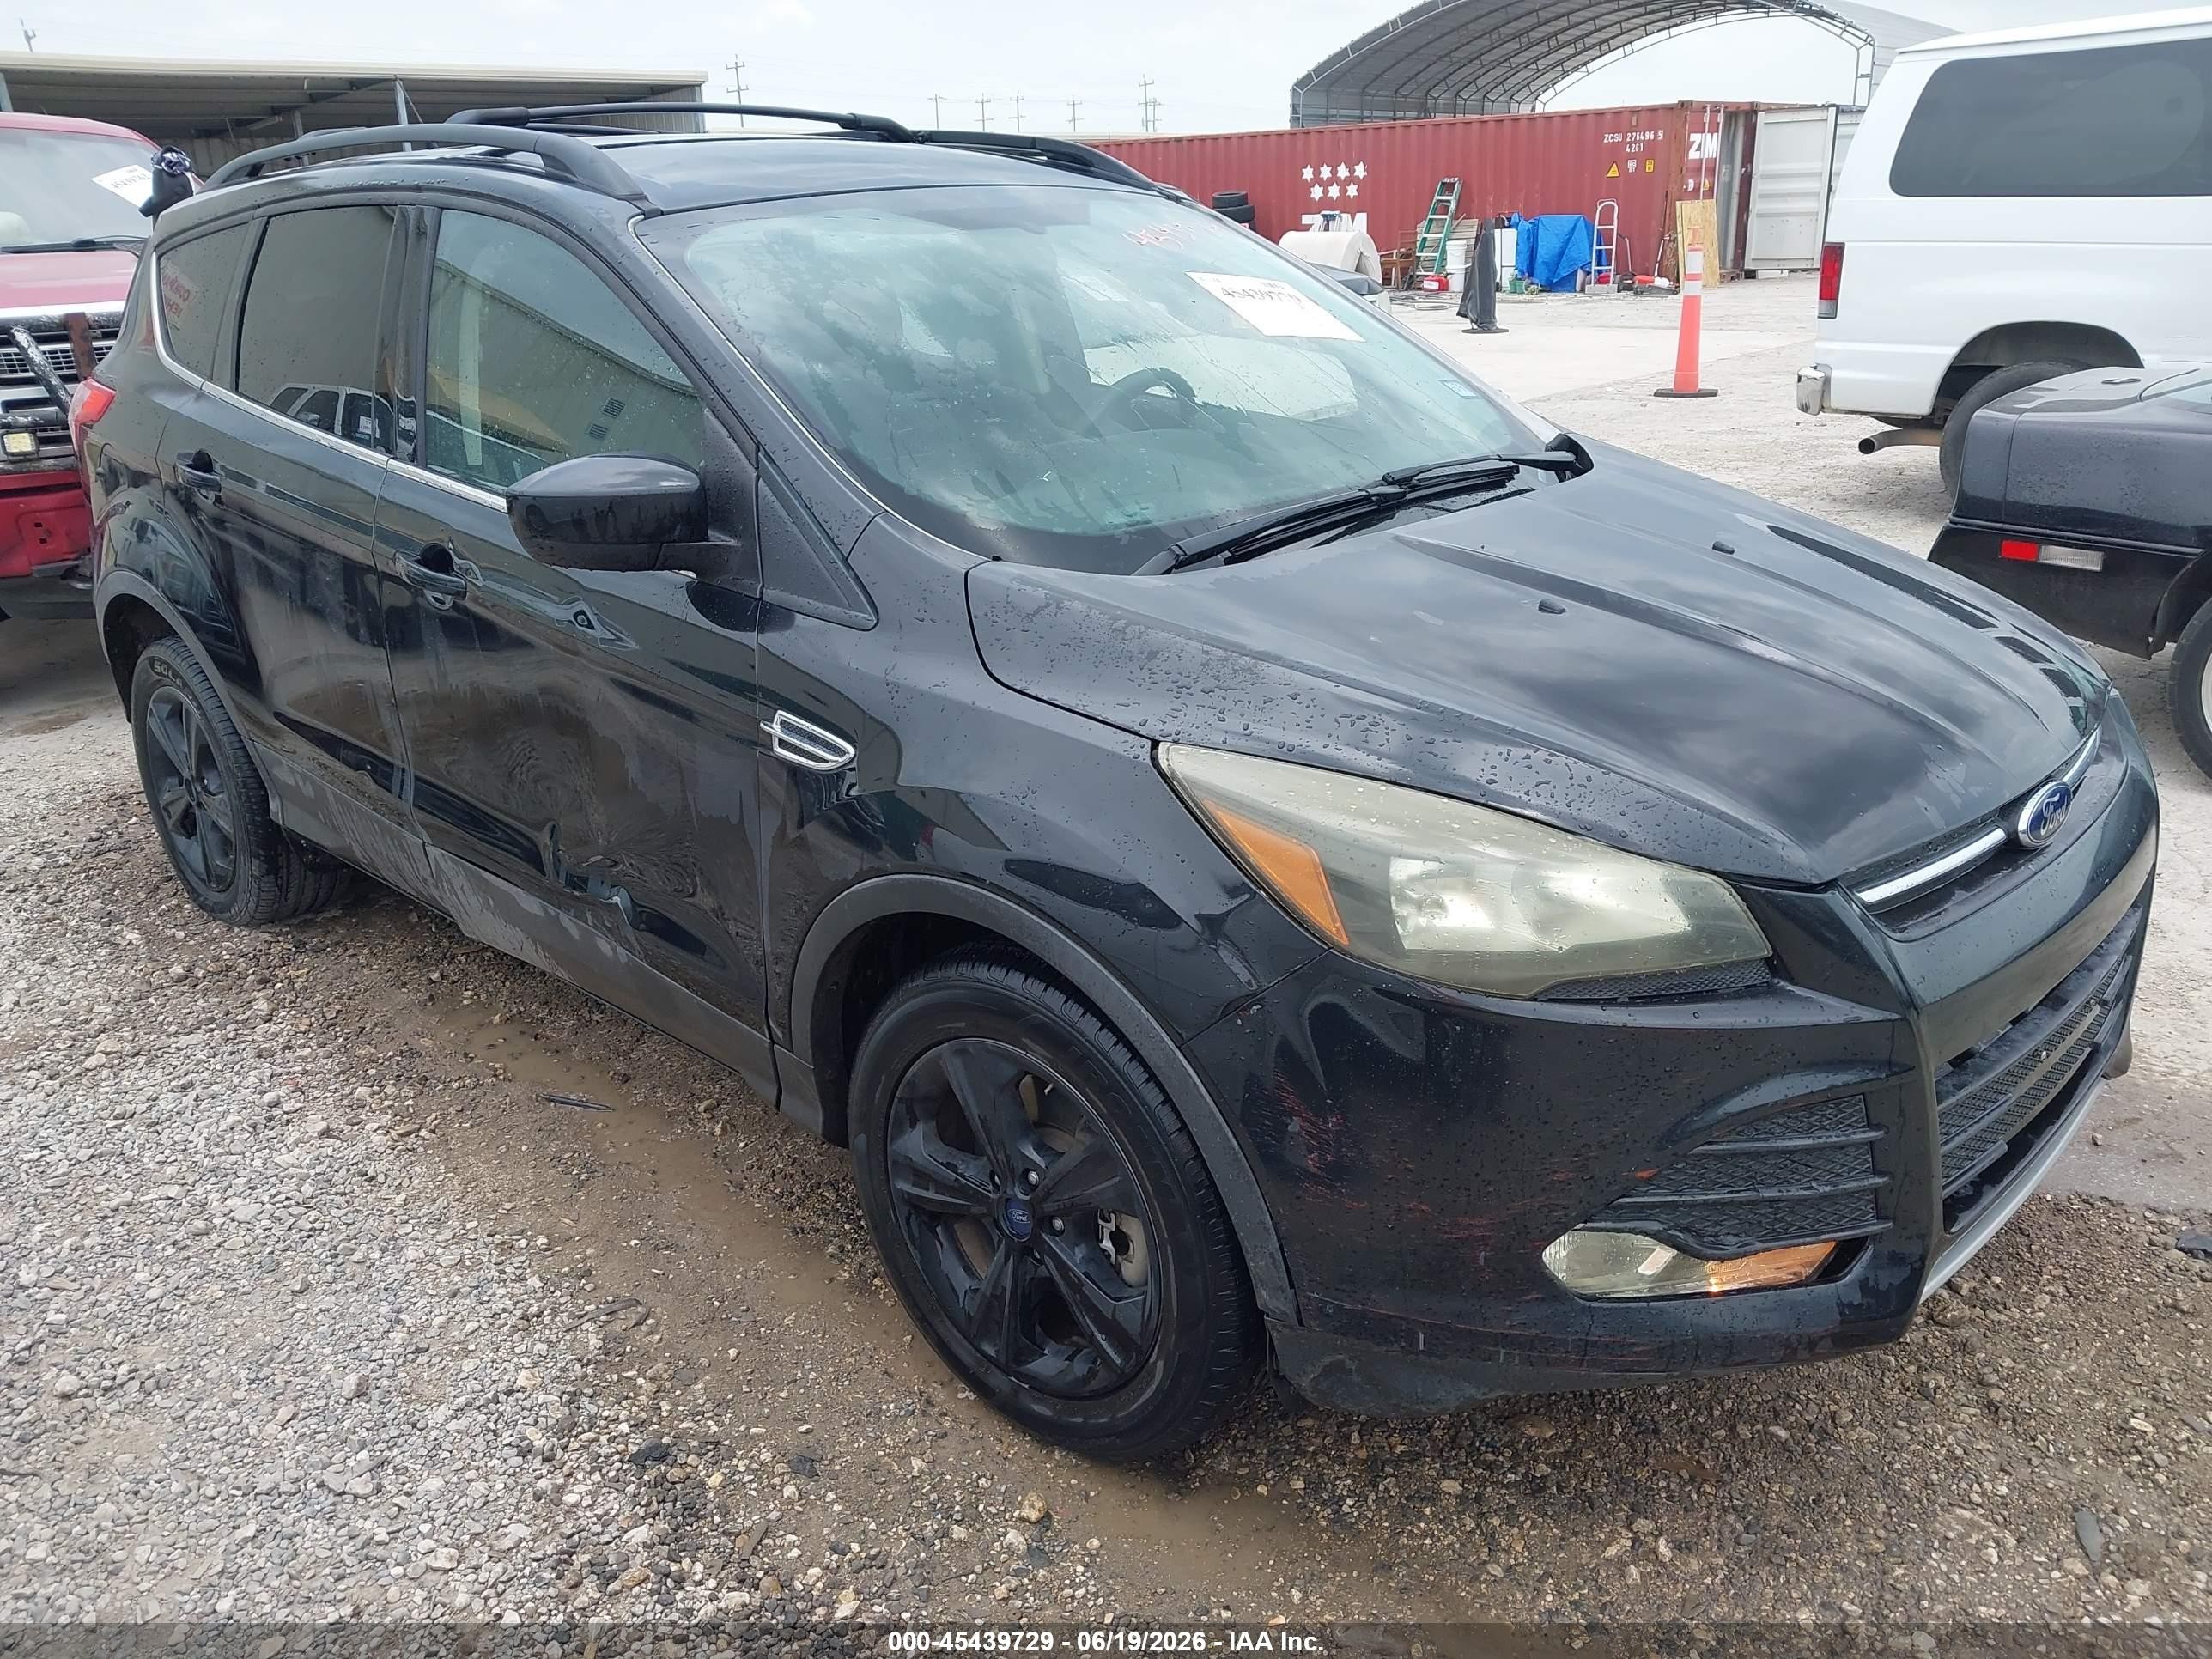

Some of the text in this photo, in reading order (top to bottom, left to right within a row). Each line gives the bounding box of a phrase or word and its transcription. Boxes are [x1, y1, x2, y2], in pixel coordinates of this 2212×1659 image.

[1603, 132, 1623, 143] ZCSU
[1688, 132, 1718, 160] ZIM
[2040, 793, 2068, 836] Ford
